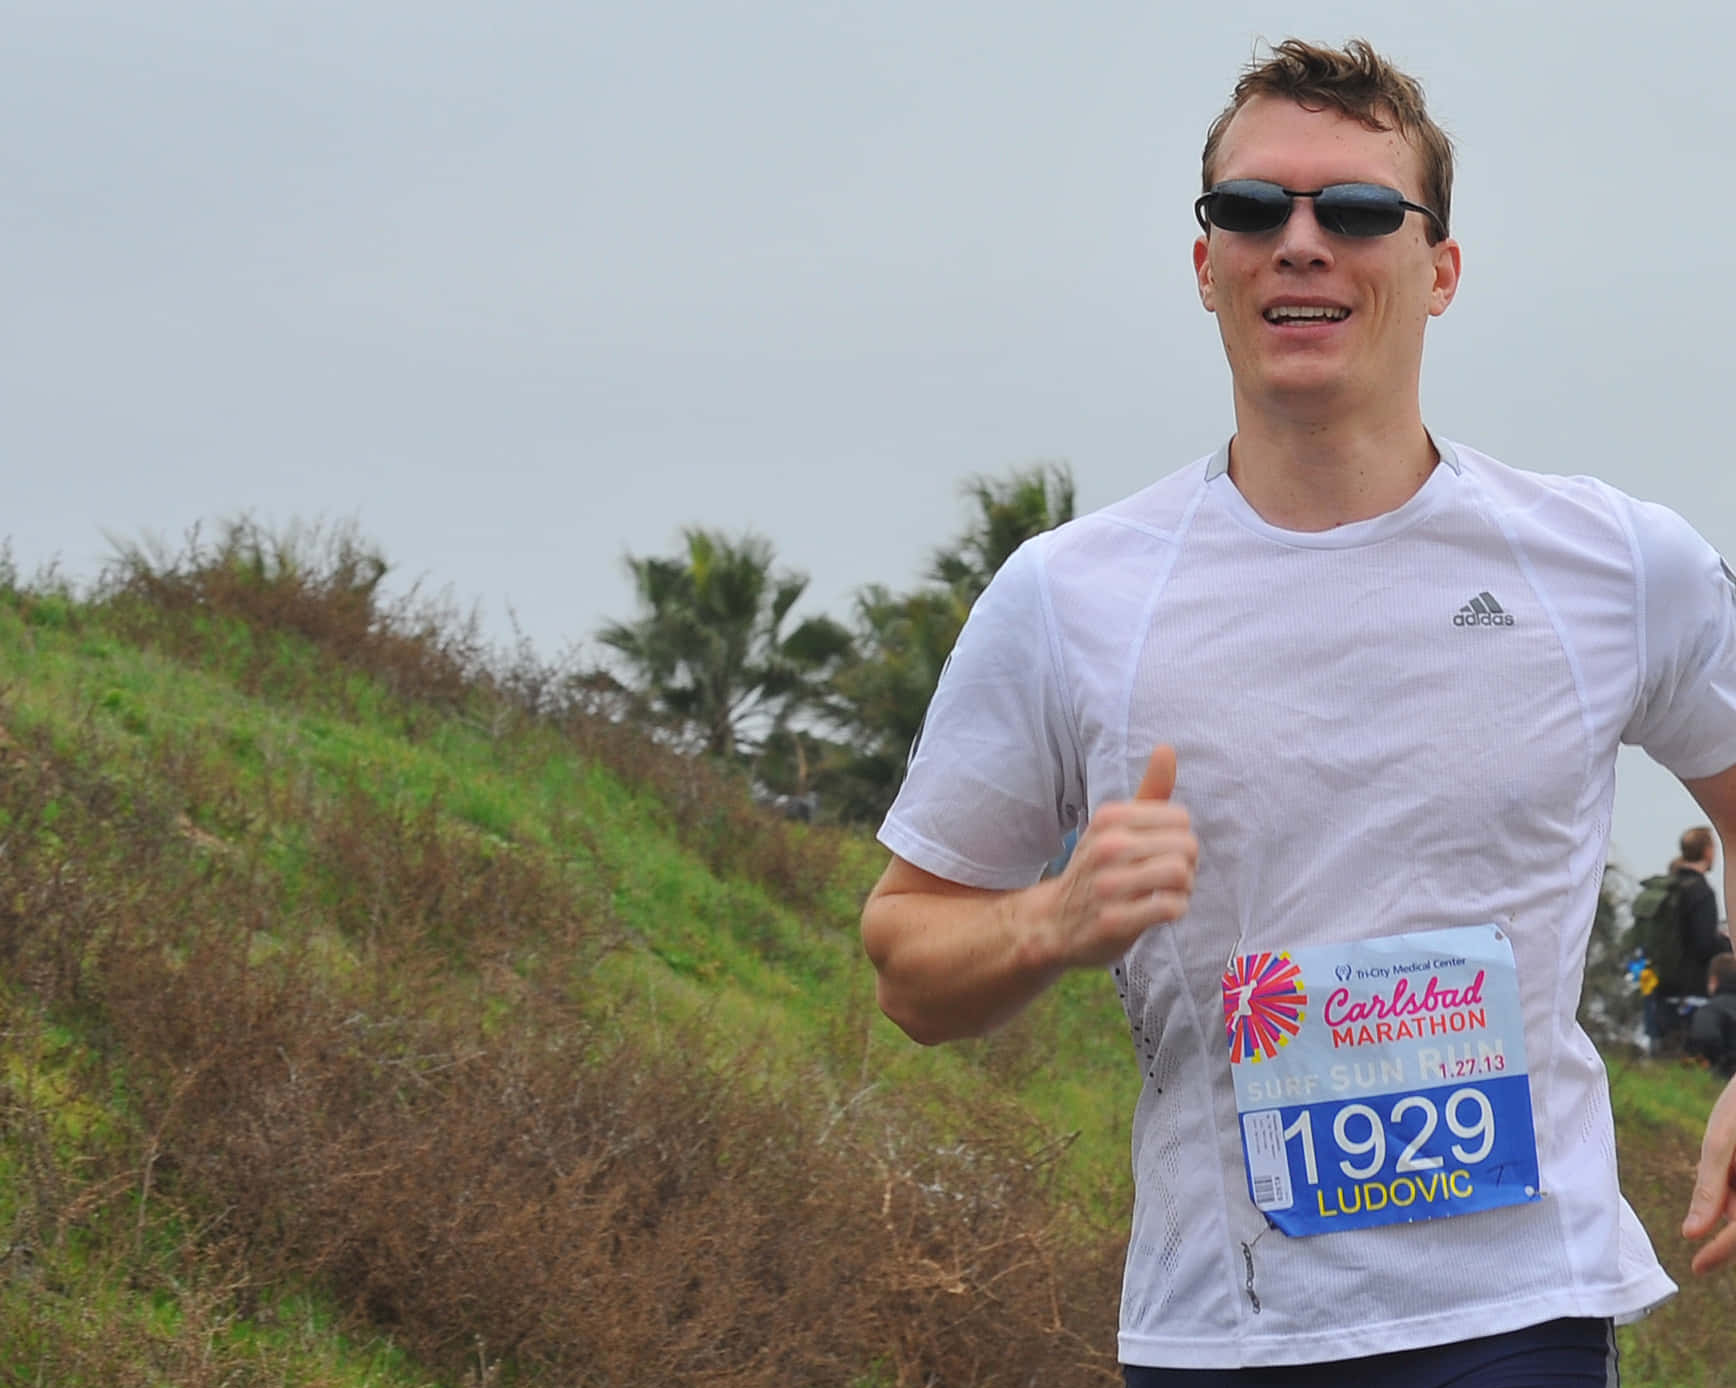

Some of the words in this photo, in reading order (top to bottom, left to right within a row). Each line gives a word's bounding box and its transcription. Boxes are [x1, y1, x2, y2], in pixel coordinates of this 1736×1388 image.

[1453, 609, 1515, 627] adidas
[1393, 960, 1431, 974] Medical
[1433, 957, 1467, 969] Center
[1324, 970, 1486, 1027] Carlsbad
[1332, 1009, 1487, 1049] MARATHON
[1247, 1074, 1321, 1102] SURF
[1329, 1057, 1405, 1092] SUN
[1418, 1039, 1505, 1081] RUN
[1439, 1055, 1506, 1080] 1.27.13
[1284, 1087, 1496, 1186] 1929
[1317, 1169, 1473, 1217] LUDOVIC
